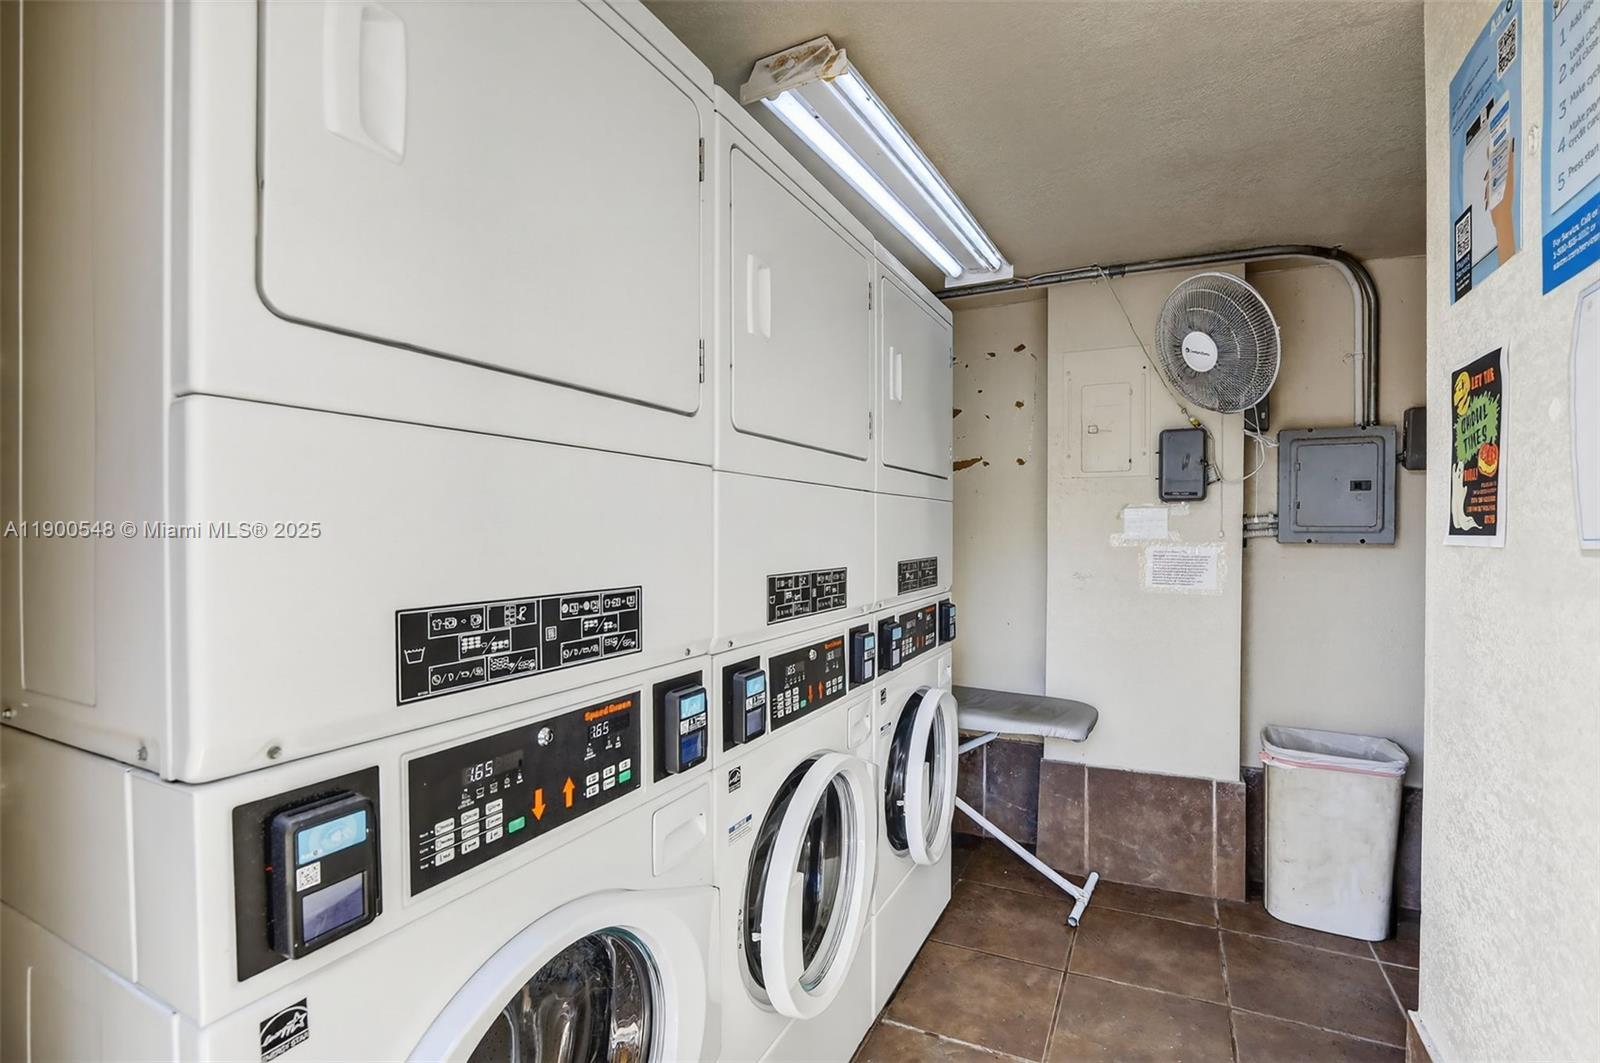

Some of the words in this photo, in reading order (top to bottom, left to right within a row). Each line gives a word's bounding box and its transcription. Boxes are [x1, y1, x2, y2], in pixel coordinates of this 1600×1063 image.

[1569, 35, 1585, 60] Load
[1559, 63, 1567, 85] 2
[1559, 99, 1566, 120] 3
[1570, 82, 1586, 105] Make
[1569, 113, 1586, 134] Make
[1557, 136, 1566, 152] 4
[1558, 171, 1566, 191] 5
